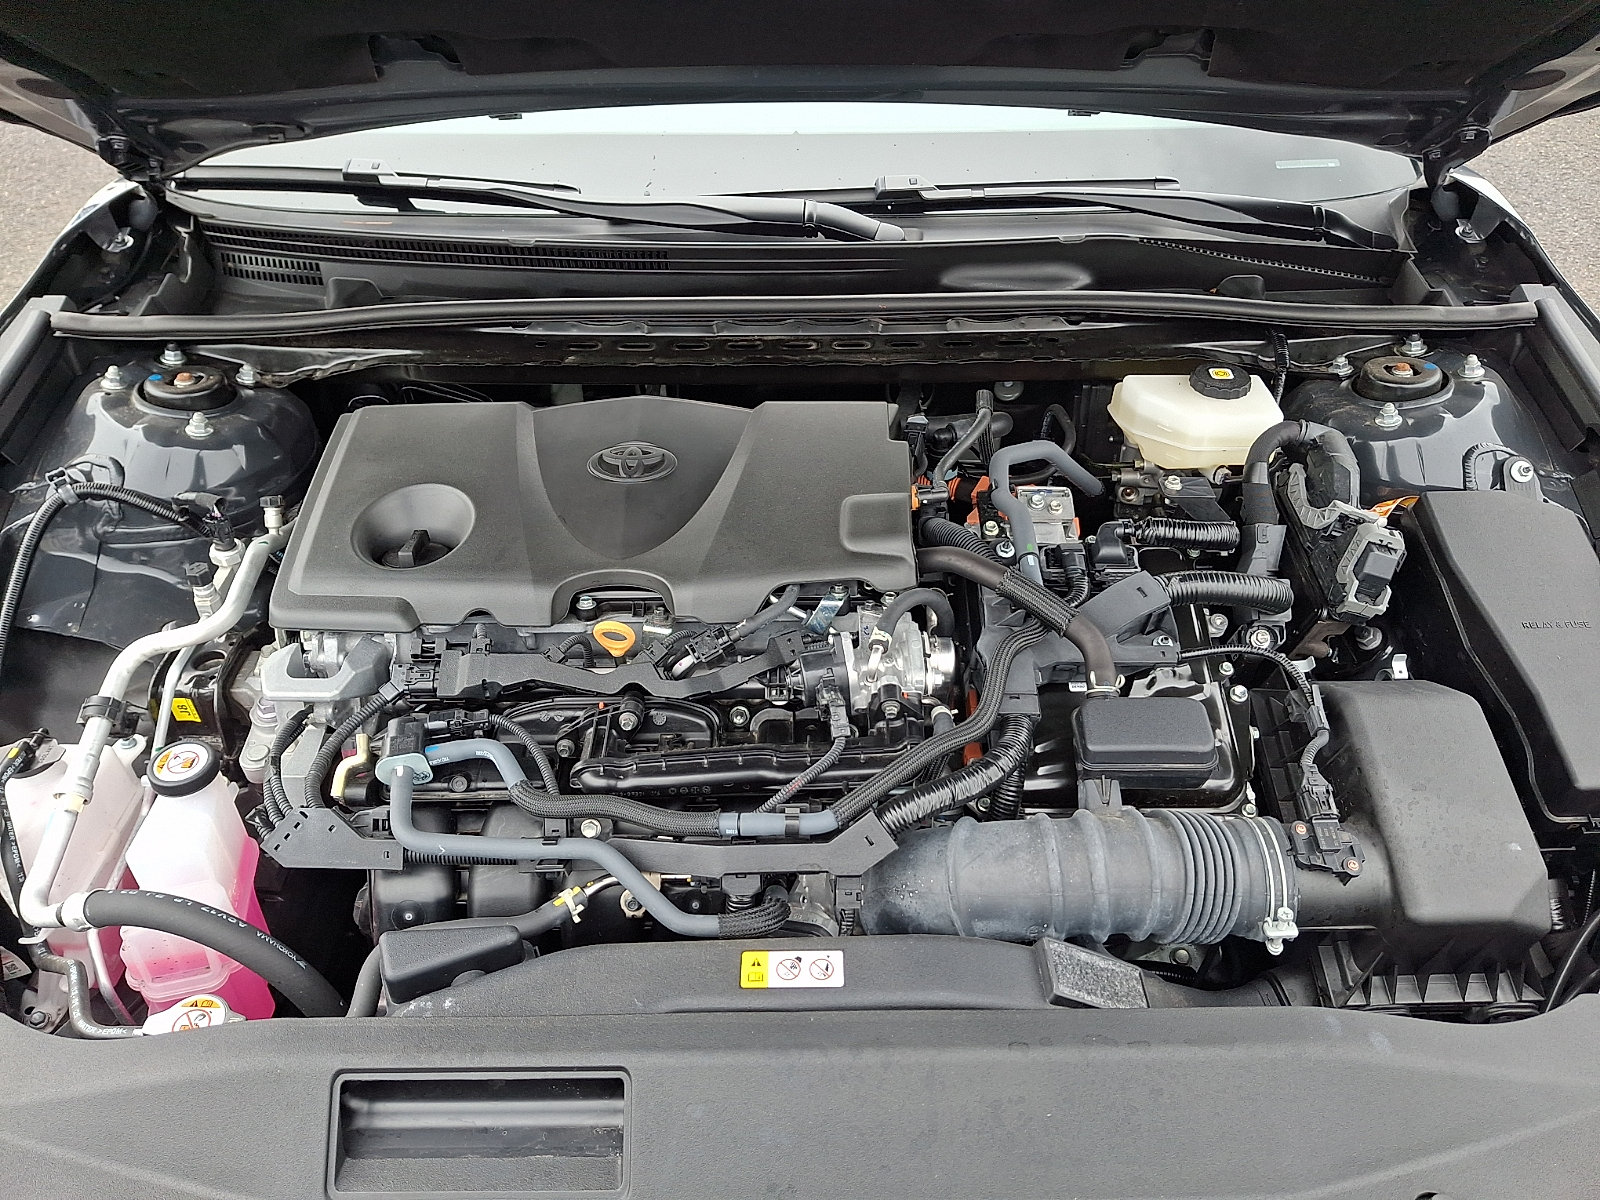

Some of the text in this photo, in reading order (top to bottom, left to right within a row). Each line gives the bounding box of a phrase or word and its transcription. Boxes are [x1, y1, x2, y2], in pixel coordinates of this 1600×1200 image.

[1521, 621, 1553, 629] RELAY
[1564, 620, 1592, 629] FUSE
[6, 821, 15, 841] WATER
[200, 905, 248, 930] ACV17
[255, 930, 298, 962] YOKOHAMA
[77, 1019, 97, 1033] WATER
